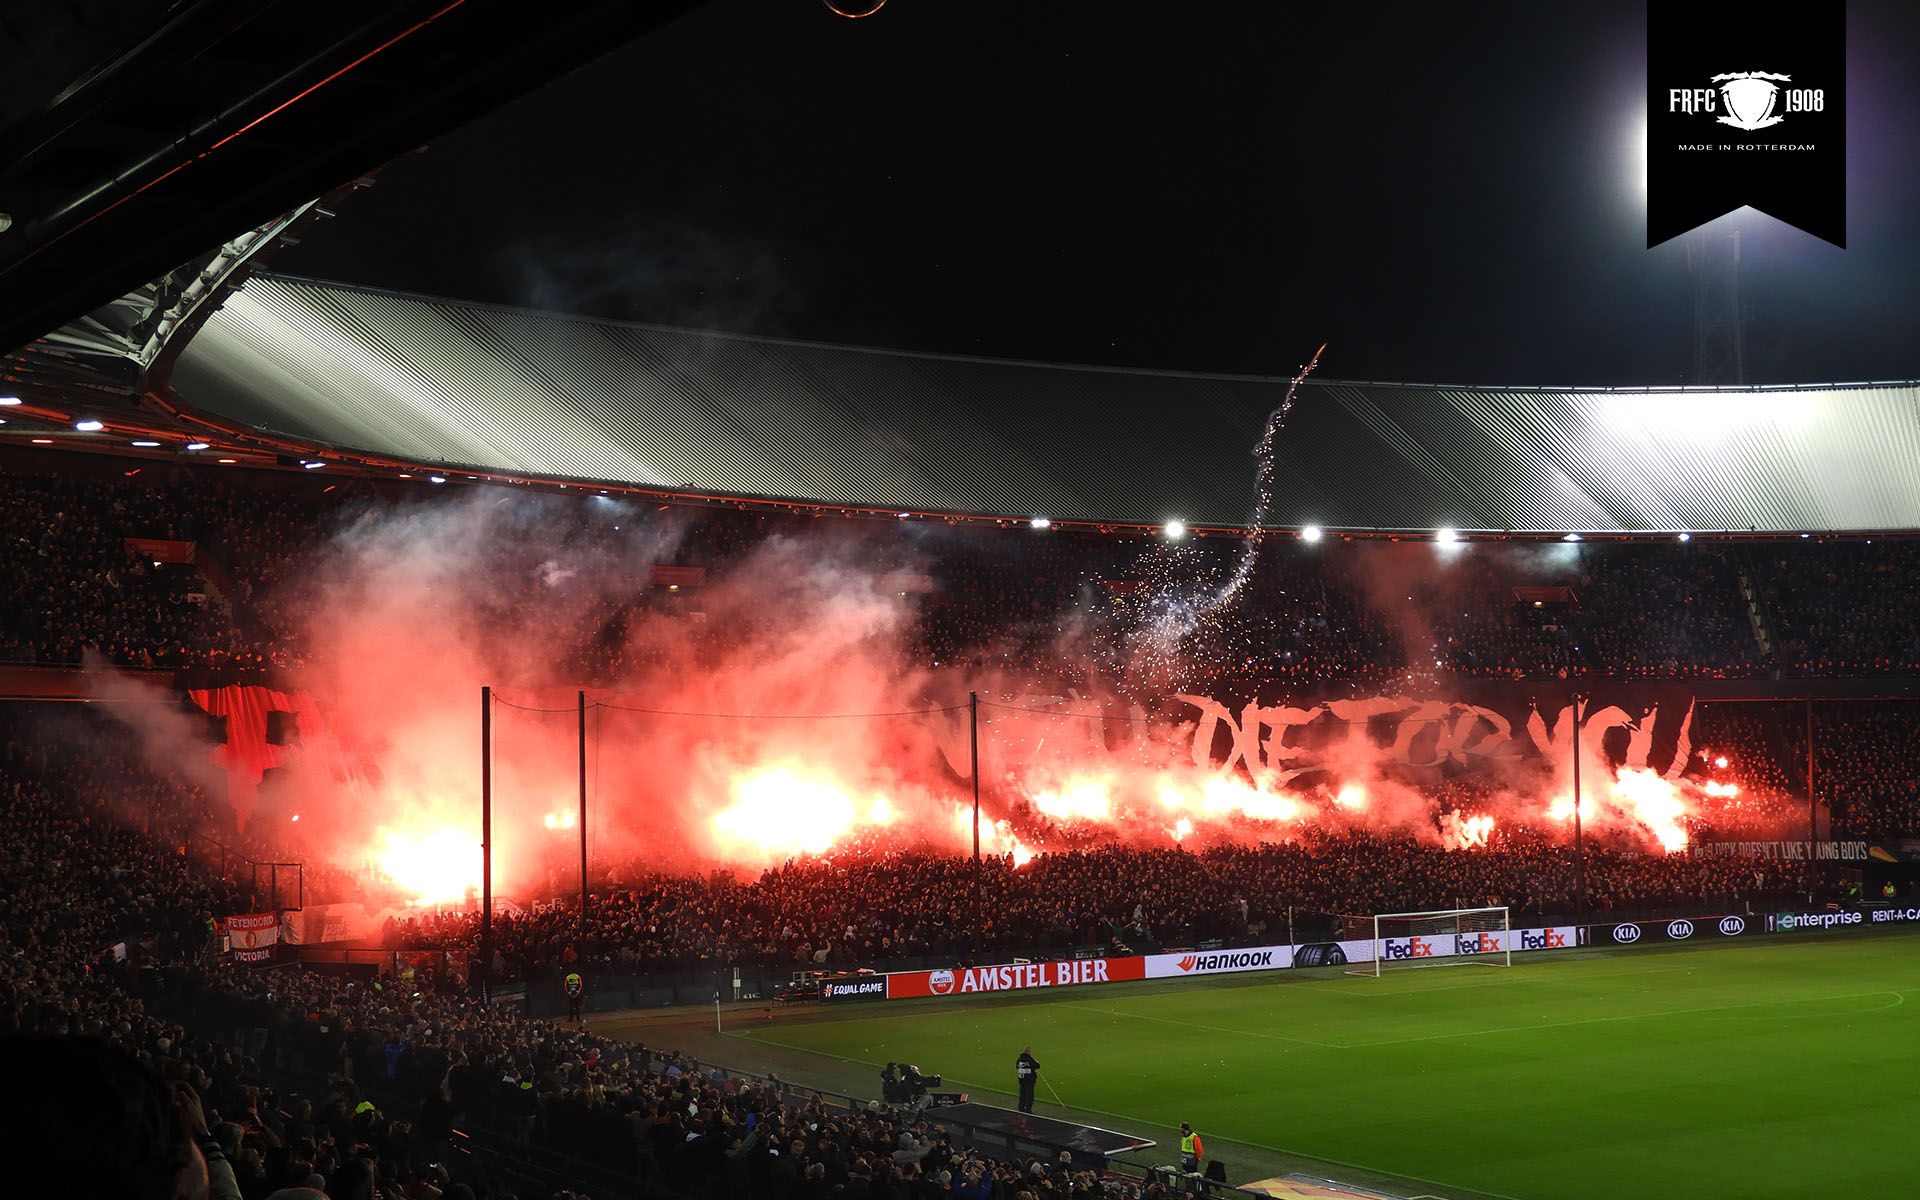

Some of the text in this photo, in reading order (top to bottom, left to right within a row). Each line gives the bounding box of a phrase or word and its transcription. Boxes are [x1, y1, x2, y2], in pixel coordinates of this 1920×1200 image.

[1781, 841, 1804, 859] LIKE
[1805, 841, 1839, 859] YUNG
[1840, 841, 1868, 859] BOYS
[228, 915, 274, 928] FEYENOORD
[1722, 920, 1741, 931] KIA
[1781, 909, 1862, 929] enterprise
[1521, 928, 1565, 950] FedEx
[1618, 928, 1637, 939] KIA
[1671, 924, 1690, 936] KIA
[1385, 937, 1433, 959] FedEx
[1455, 933, 1500, 954] FedEx
[234, 949, 271, 962] VICTORIA
[961, 959, 1110, 992] AMSTEL BIER
